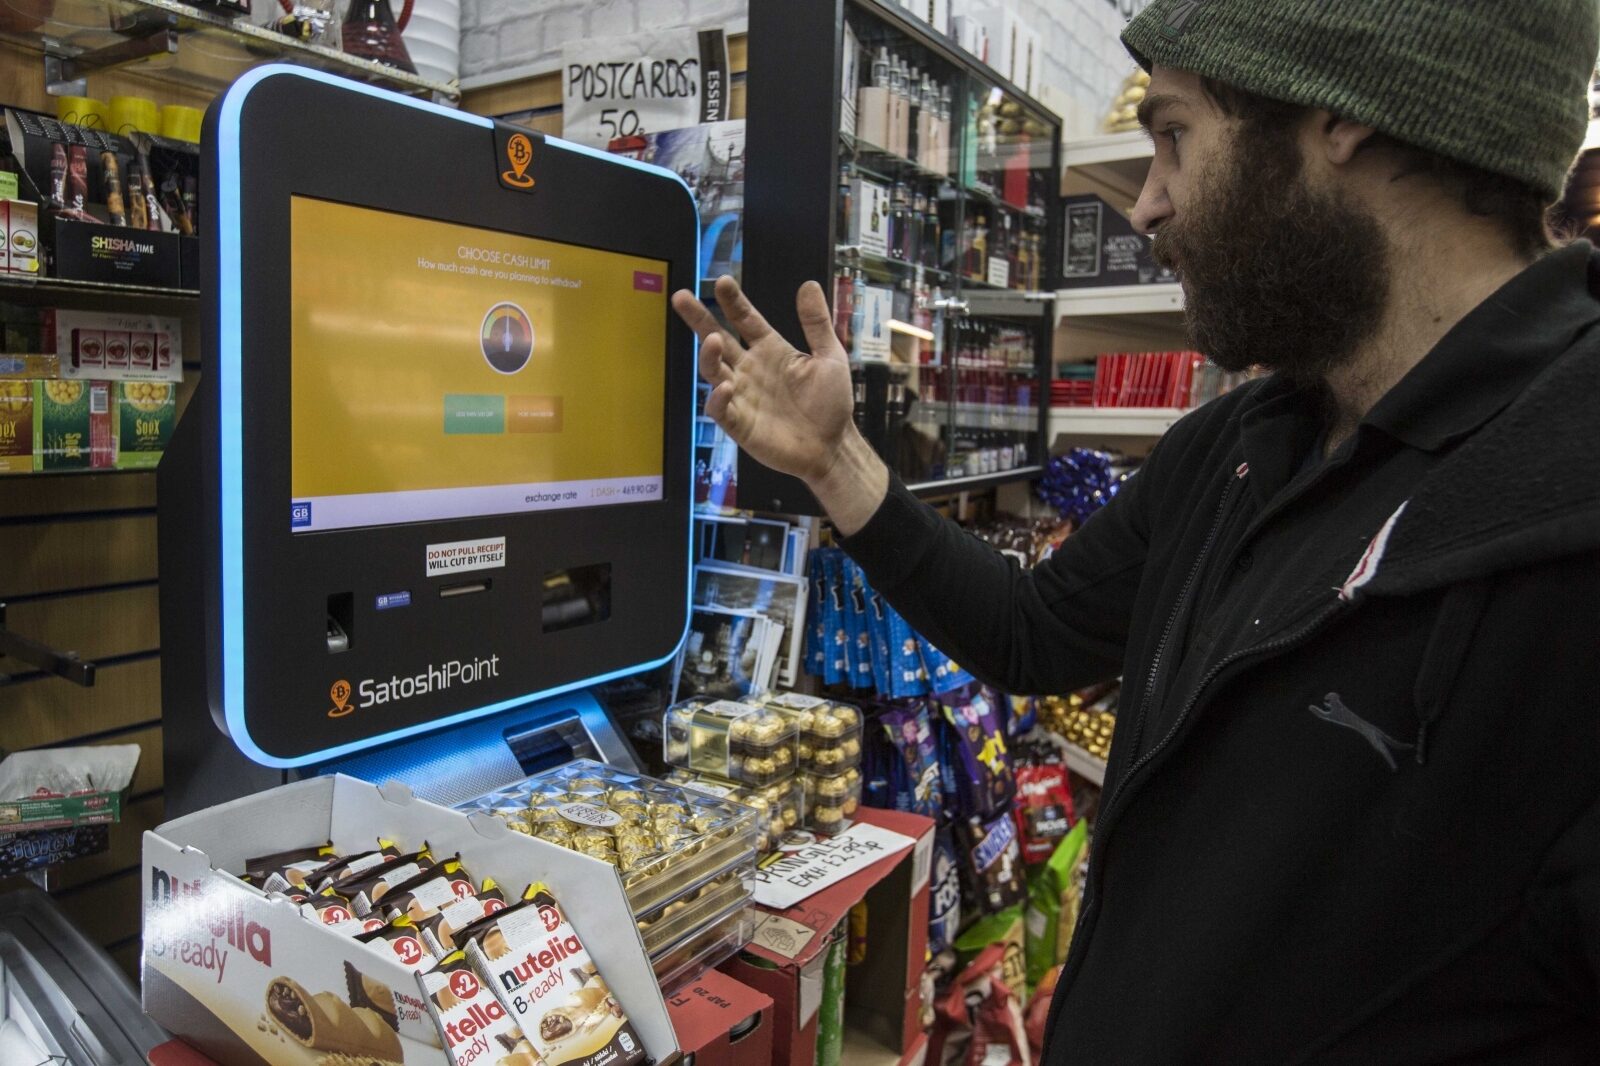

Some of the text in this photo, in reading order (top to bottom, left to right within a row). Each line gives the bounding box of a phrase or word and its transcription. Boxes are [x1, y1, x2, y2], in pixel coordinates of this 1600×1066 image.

[457, 246, 551, 270] CHOOSE CASH LIMIT
[417, 257, 436, 269] How
[437, 260, 458, 273] much
[459, 263, 478, 275] cash
[479, 268, 493, 278] are
[495, 271, 508, 280] you
[509, 271, 540, 285] planning
[541, 275, 549, 285] to
[525, 492, 562, 503] exchange
[562, 490, 578, 500] rate
[293, 508, 308, 518] GB
[428, 543, 505, 560] DO NOT PULL RECEIPT
[428, 552, 504, 570] WILL CUT BY ITSELF
[358, 653, 500, 708] SatoshiPoint
[499, 934, 584, 991] nutella
[455, 974, 477, 997] x2
[512, 966, 564, 1015] B-ready
